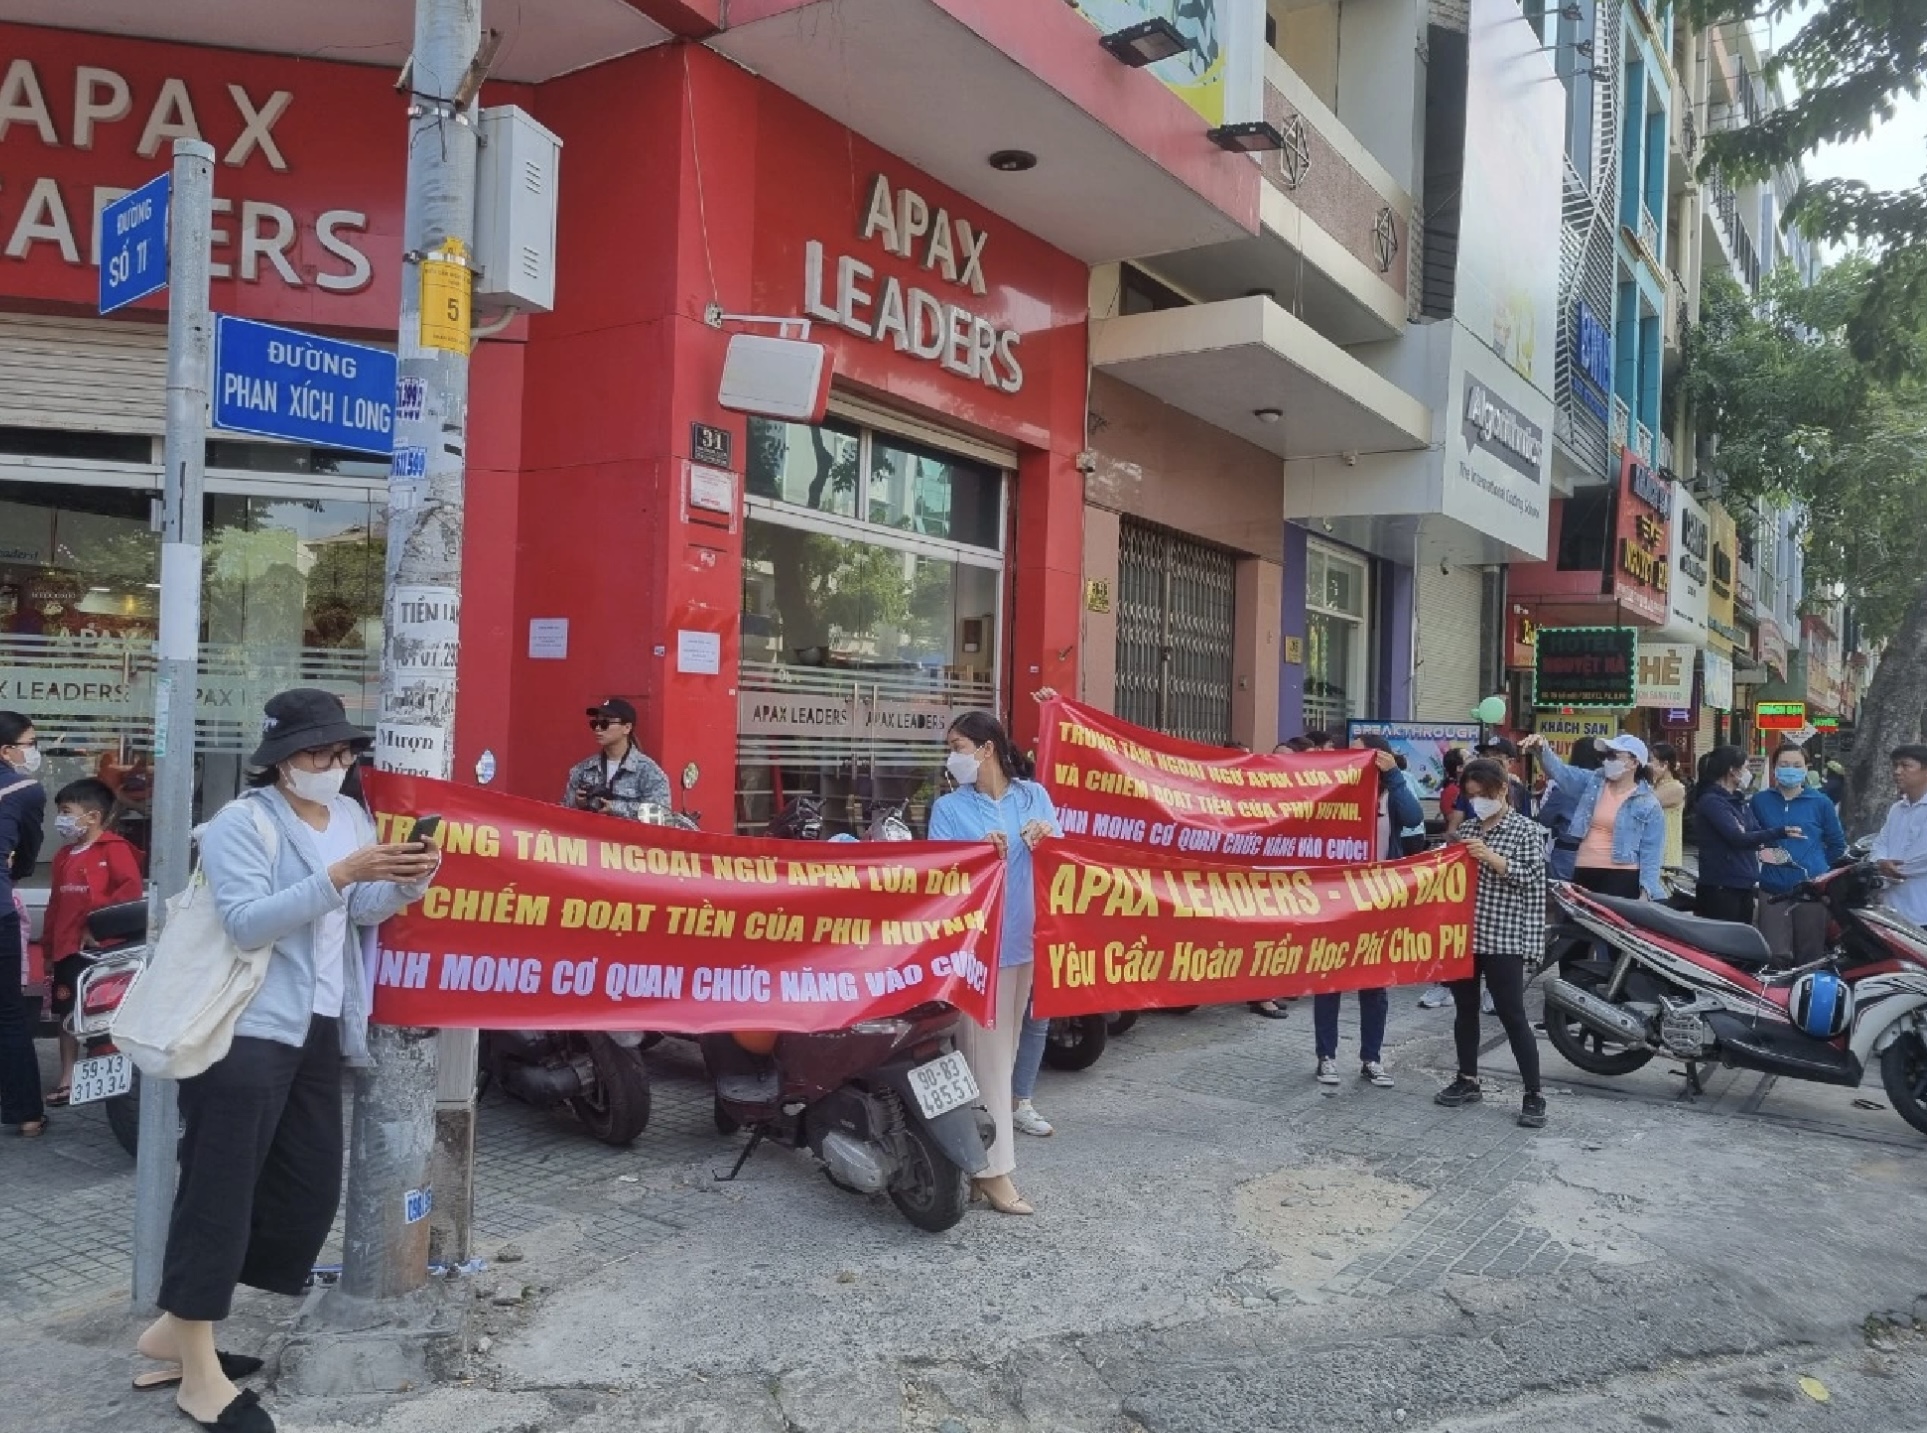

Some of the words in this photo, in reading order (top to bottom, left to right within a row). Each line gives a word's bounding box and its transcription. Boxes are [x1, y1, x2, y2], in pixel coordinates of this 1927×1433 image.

[0, 59, 293, 171] APAX
[117, 198, 152, 236] ĐƯỜNG
[860, 173, 988, 295] APAX
[109, 237, 130, 288] SỐ
[447, 298, 459, 321] 5
[804, 240, 1023, 394] LEADERS
[267, 341, 357, 379] ĐƯỜNG
[224, 372, 277, 413] PHAN
[288, 380, 334, 424] XÍCH
[343, 395, 391, 433] LONG
[16, 681, 130, 702] LEADERS
[752, 704, 787, 723] APAX
[791, 707, 847, 726] LEADERS
[897, 713, 945, 729] LEADERS
[1353, 724, 1479, 738] BREAKTHROUGH
[1540, 718, 1579, 734] KHÁCH
[1059, 722, 1118, 755] TRUNG
[1247, 770, 1293, 788] APAX
[1055, 763, 1079, 788] VÀ
[1084, 770, 1149, 800] CHIẾM
[1279, 801, 1314, 823] PHỤ
[1055, 805, 1088, 835] ÍNH
[1092, 814, 1145, 842] MONG
[1149, 820, 1177, 847] CƠ
[1178, 827, 1219, 853] QUAN
[512, 830, 589, 867] TÂM
[600, 841, 701, 882] NGOẠI
[711, 855, 778, 884] NGỮ
[788, 861, 861, 890] APAX
[1049, 864, 1160, 917] APAX
[1164, 868, 1321, 918] LEADERS
[1343, 861, 1409, 911] LỪA
[1411, 852, 1467, 906] ĐẢO
[423, 883, 550, 926] CHIẾM
[560, 898, 656, 937] ĐOẠT
[666, 898, 736, 939] TIỀN
[744, 907, 805, 942] CỦA
[812, 916, 871, 950] PHỤ
[438, 953, 542, 993] MONG
[551, 957, 598, 996] CƠ
[605, 962, 684, 1001] QUAN
[692, 964, 771, 1001] CHỨC
[781, 967, 859, 1002] NĂNG
[865, 964, 923, 997] VÀO
[1048, 942, 1096, 989] Yêu
[1104, 934, 1165, 983] Cầu
[1168, 941, 1244, 981] Hoàn
[1248, 933, 1303, 978] Tiền
[1305, 937, 1349, 982] Học
[1351, 927, 1389, 967] Phí
[1388, 927, 1432, 963] Cho
[1439, 924, 1468, 960] PH
[74, 1073, 126, 1101] 313.34
[82, 1055, 123, 1080] 59-X3
[923, 1076, 974, 1112] 485.51
